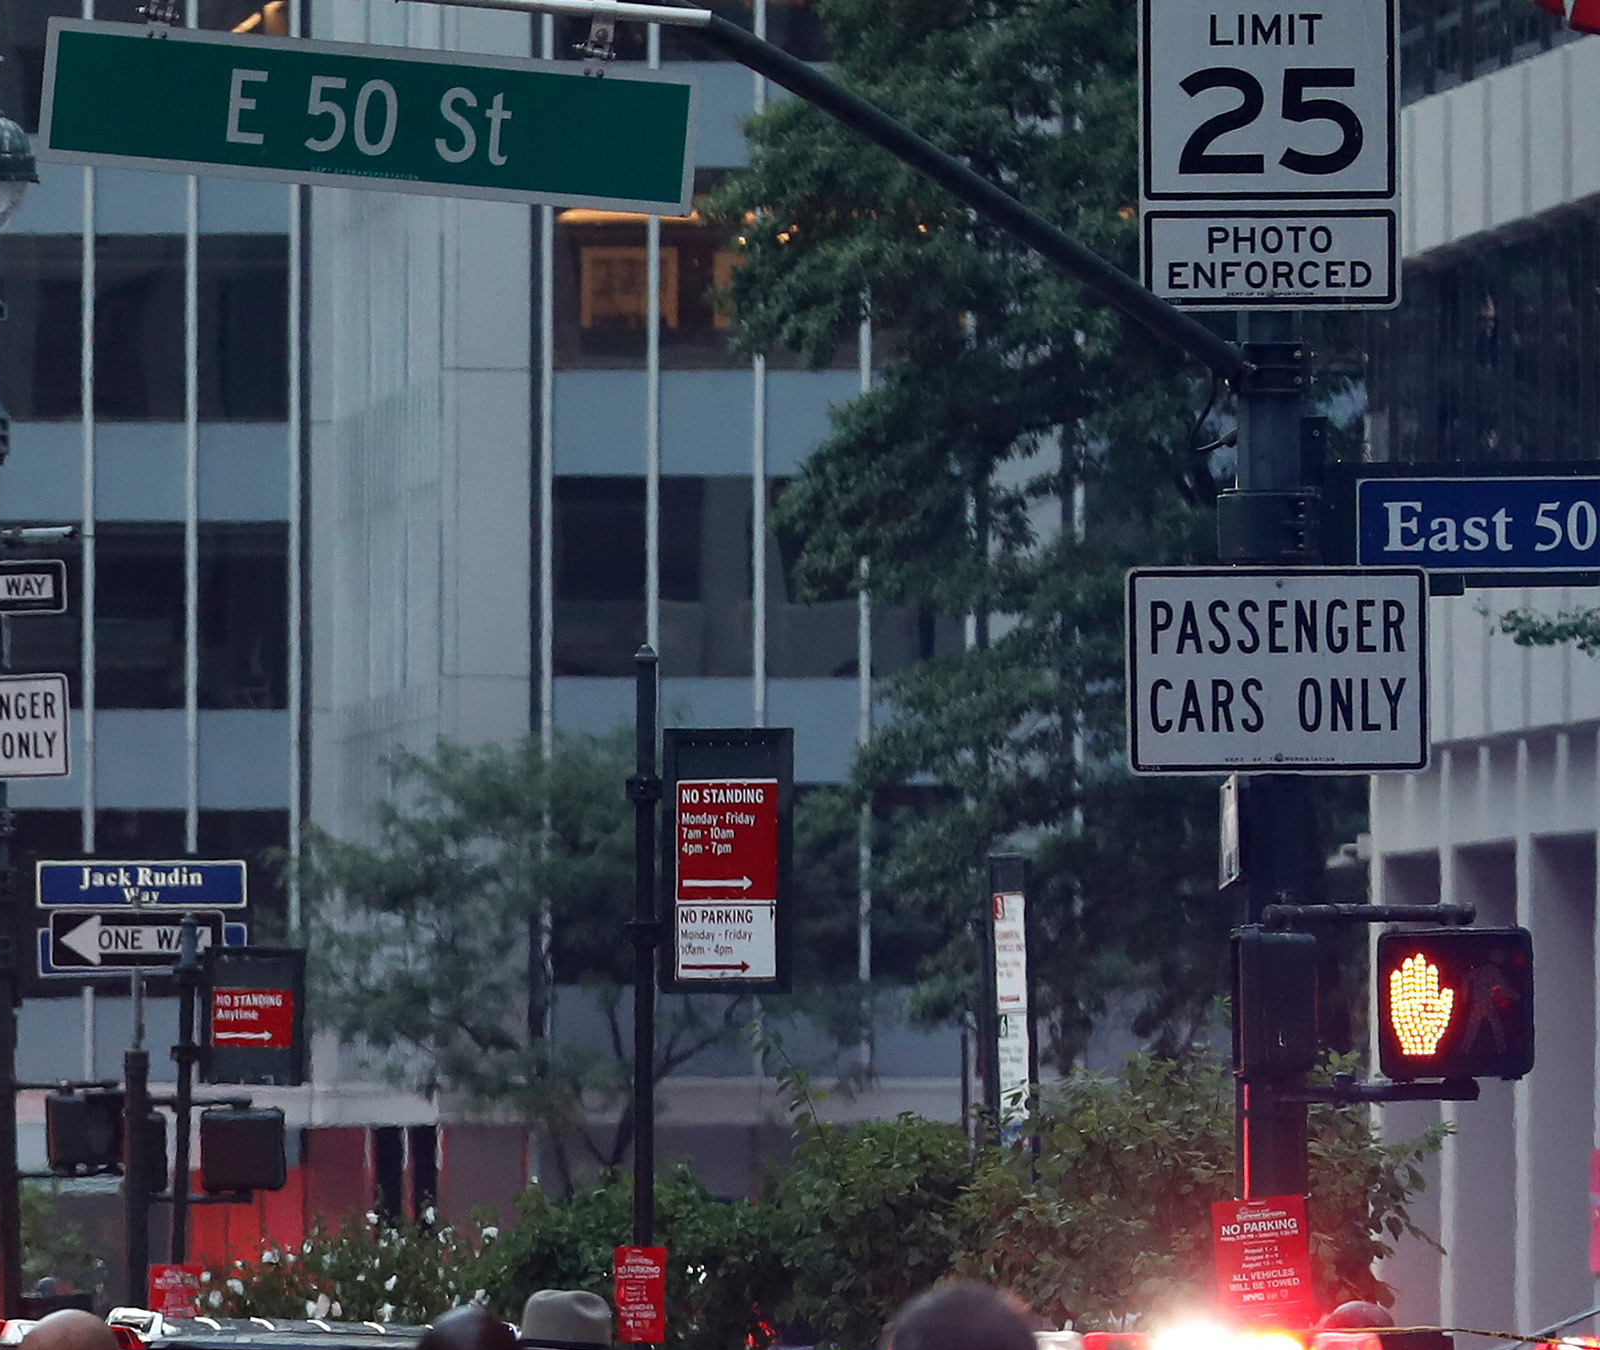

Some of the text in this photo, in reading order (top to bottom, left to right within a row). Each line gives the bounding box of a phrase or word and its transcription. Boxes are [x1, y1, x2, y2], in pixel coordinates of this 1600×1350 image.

[1210, 14, 1323, 46] LIMIT
[225, 68, 512, 167] E 50 St
[1179, 67, 1364, 175] 25
[1207, 226, 1333, 254] PHOTO
[1168, 262, 1373, 289] ENFORCED
[1383, 501, 1597, 553] East 50
[6, 576, 47, 597] WAY
[1150, 600, 1406, 655] PASSENGER
[1150, 677, 1406, 733] CARS ONLY
[2, 731, 58, 760] ONLY
[682, 788, 764, 804] NO STANDING
[682, 812, 756, 827] Monday Friday
[682, 827, 735, 839] 7am 10am
[681, 842, 732, 856] 4pm 7pm
[79, 867, 203, 891] Jack Rudin
[123, 888, 160, 903] Way
[680, 909, 754, 924] NO PARKING
[100, 928, 143, 950] ONE
[681, 929, 753, 942] Monday Friday
[714, 943, 733, 957] 4pm
[217, 994, 283, 1007] NO STANDING
[216, 1009, 259, 1021] Anytime
[1221, 1223, 1241, 1236] NO
[1243, 1217, 1298, 1233] PARKING
[1232, 1267, 1295, 1282] ALL VEHICLES
[1267, 1277, 1300, 1288] TOWED
